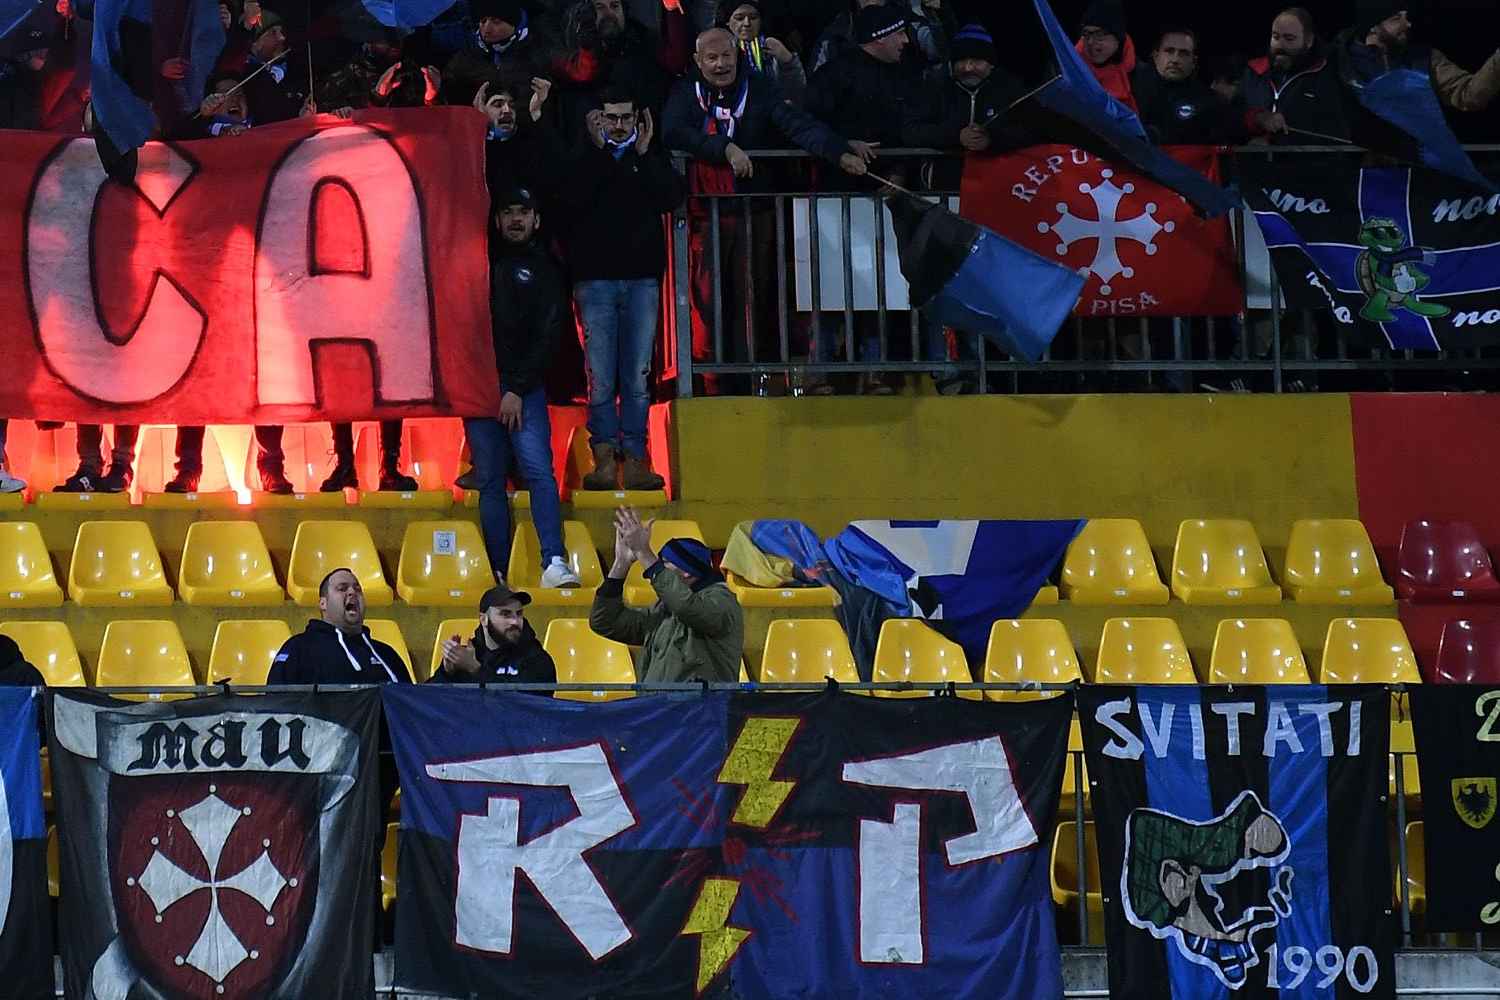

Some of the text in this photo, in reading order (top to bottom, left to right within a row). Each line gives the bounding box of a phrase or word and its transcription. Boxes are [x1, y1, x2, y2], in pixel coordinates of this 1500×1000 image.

[1011, 148, 1103, 203] REPU
[1091, 291, 1160, 315] PISA
[1094, 696, 1363, 761] SVITATI
[425, 734, 1039, 964] R P
[1263, 943, 1380, 994] 1990
